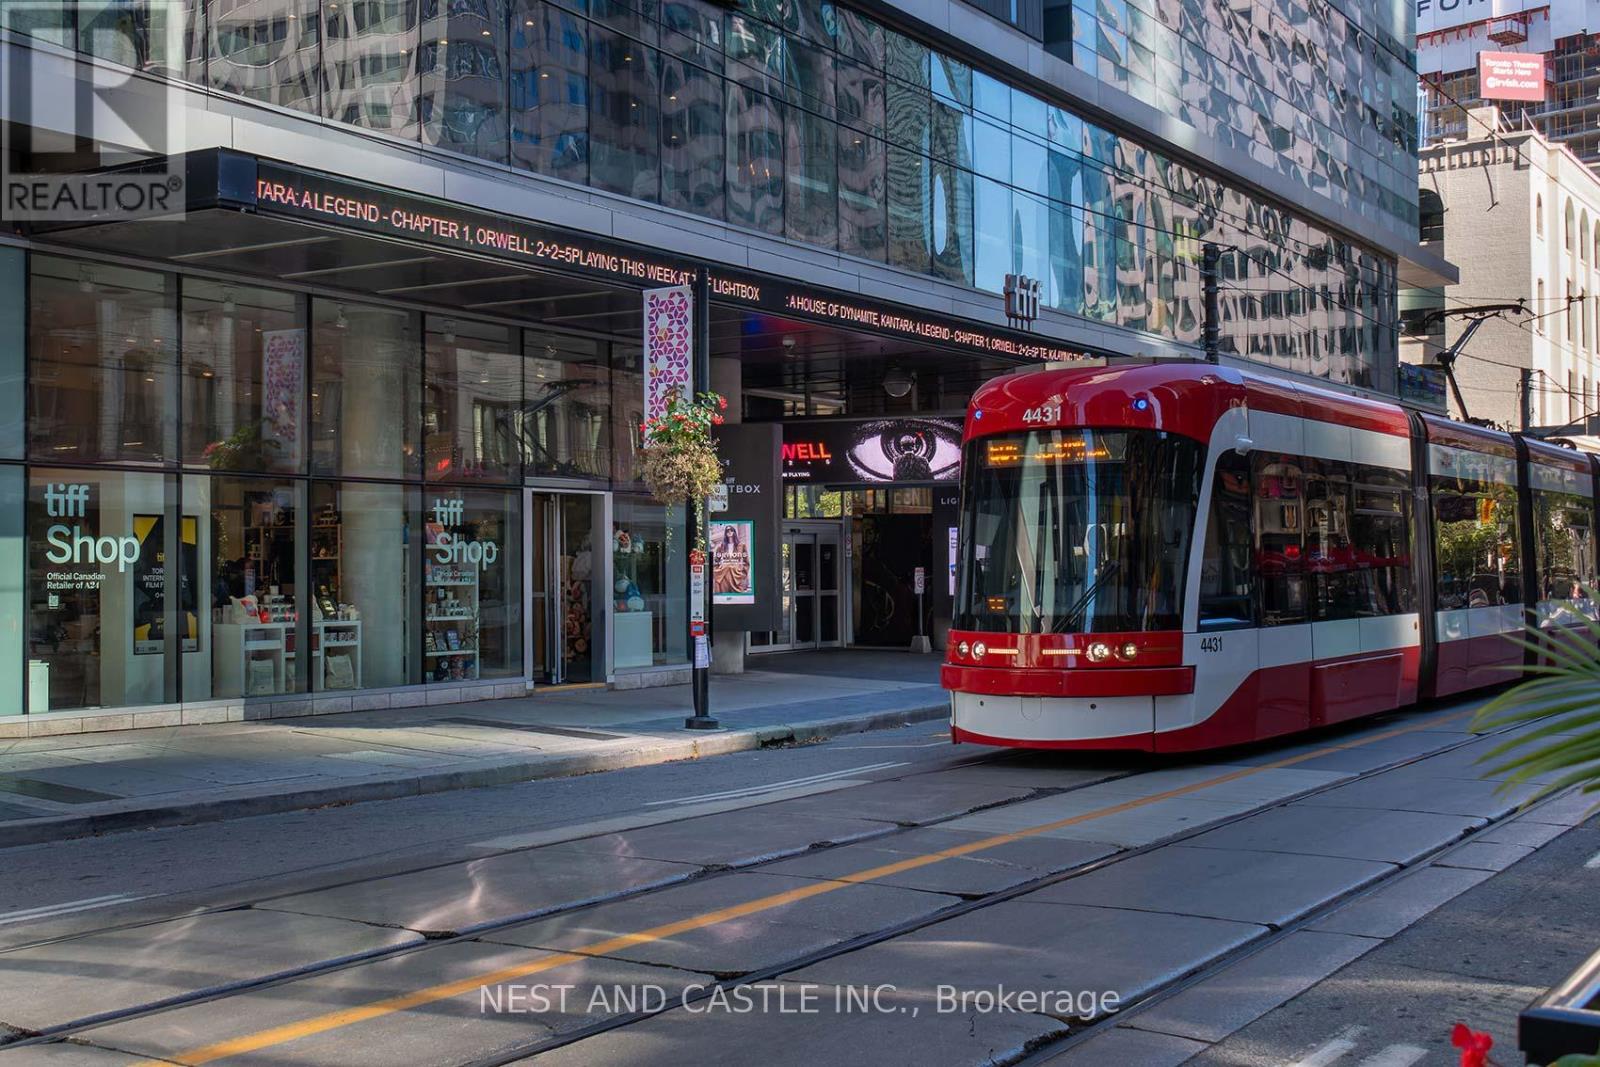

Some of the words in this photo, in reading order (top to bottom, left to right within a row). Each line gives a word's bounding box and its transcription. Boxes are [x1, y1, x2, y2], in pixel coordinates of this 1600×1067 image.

[301, 191, 312, 209] A
[314, 195, 379, 223] LEGEND
[391, 210, 459, 239] CHAPTER
[463, 225, 474, 245] 1,
[476, 228, 535, 254] ORWELL:
[620, 258, 645, 278] THIS
[647, 264, 677, 284] WEEK
[679, 271, 690, 285] AT
[713, 278, 760, 301] LIGHTBOX
[1003, 273, 1042, 321] tiff
[797, 296, 827, 315] HOUSE
[828, 303, 840, 317] OF
[915, 322, 921, 334] A
[921, 323, 950, 340] LEGEND
[954, 330, 985, 347] CHAPTER
[1022, 407, 1062, 423] 4431
[782, 443, 832, 460] WELL
[44, 483, 89, 517] tiff
[729, 485, 760, 494] TBOX
[434, 498, 464, 526] tiff
[46, 524, 141, 573] Shop
[435, 532, 497, 571] Shop
[47, 572, 72, 580] Official
[73, 572, 106, 580] Canadian
[1200, 636, 1223, 652] 4431
